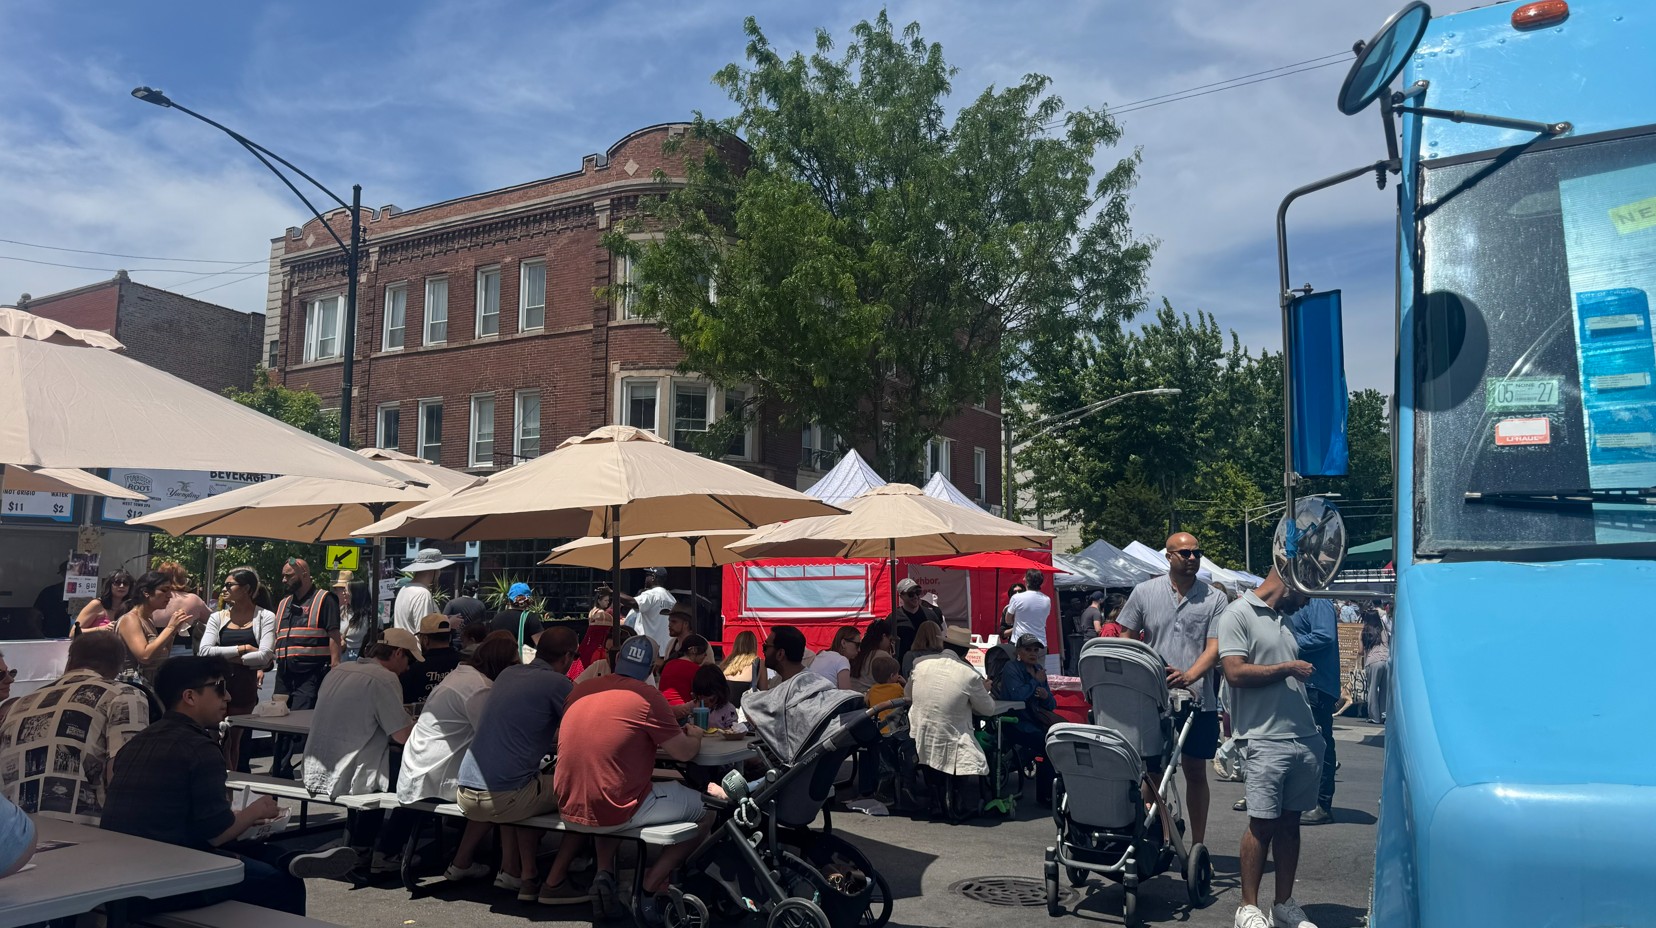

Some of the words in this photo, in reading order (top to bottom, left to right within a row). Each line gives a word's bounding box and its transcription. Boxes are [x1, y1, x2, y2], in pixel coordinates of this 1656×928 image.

[1498, 383, 1514, 403] 05
[1538, 382, 1554, 403] 27
[127, 483, 151, 492] ROOT
[8, 501, 24, 512] $11
[52, 503, 64, 514] $2
